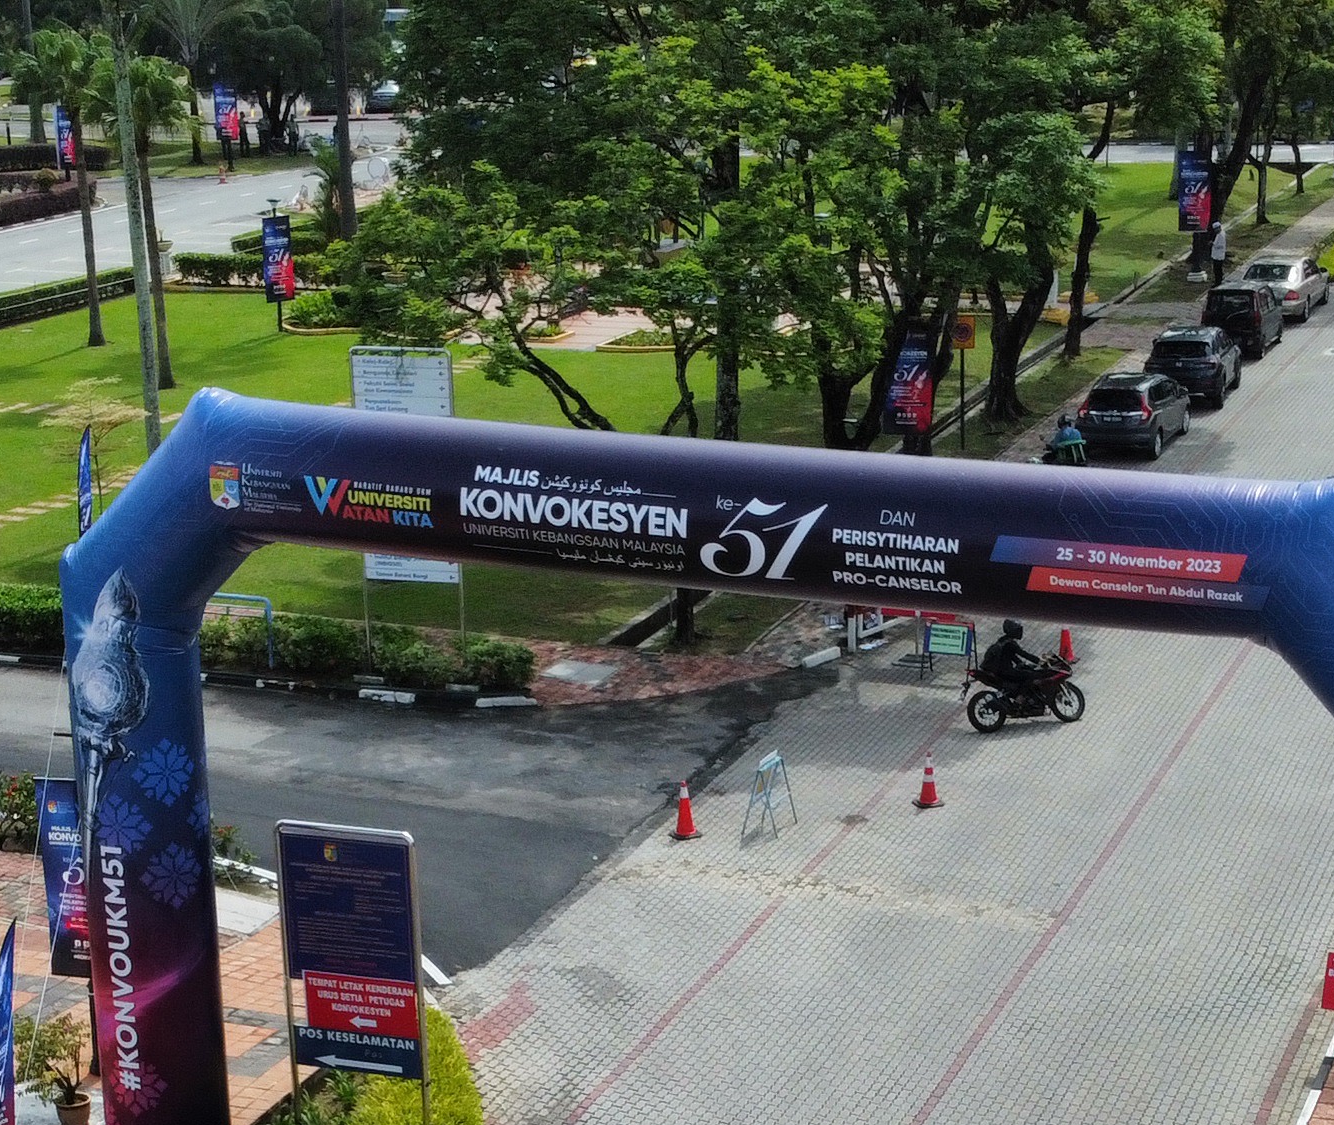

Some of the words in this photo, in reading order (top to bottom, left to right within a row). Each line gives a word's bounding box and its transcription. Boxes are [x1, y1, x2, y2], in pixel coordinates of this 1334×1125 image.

[474, 465, 540, 487] MAJLIS
[347, 490, 431, 511] UNIVERSITI
[393, 510, 434, 529] KITA
[460, 487, 688, 538] KONVOKESYEN
[879, 509, 916, 527] DAN
[463, 522, 530, 540] UNIVERSITI
[532, 529, 619, 549] KEBANGSAAN
[622, 538, 686, 556] MALAYSIA
[832, 527, 960, 555] PERISYTIHARAN
[845, 551, 946, 574] PELANTIKAN
[1056, 546, 1074, 562] 25
[1087, 549, 1106, 564] 30
[1109, 551, 1183, 571] November
[1186, 557, 1222, 574] 2023
[832, 571, 963, 595] PRO-CANSELOR
[1049, 574, 1089, 589] Dewan
[1091, 578, 1143, 594] Canselor
[1146, 582, 1167, 596] Tun
[1169, 584, 1204, 599] Abdul
[1207, 588, 1244, 603] Razak
[100, 845, 142, 1091] #KONVOUKM51
[307, 977, 337, 989] TEMPAT
[339, 981, 364, 992] LETAK
[365, 984, 414, 997] KENDERAAN
[317, 990, 339, 1000] URUS
[341, 992, 364, 1003] SETIA
[369, 995, 406, 1008] PETUGAS
[331, 1002, 392, 1017] KONVOKESYEN
[299, 1027, 323, 1039] POS
[327, 1031, 415, 1051] KESELAMATAN
